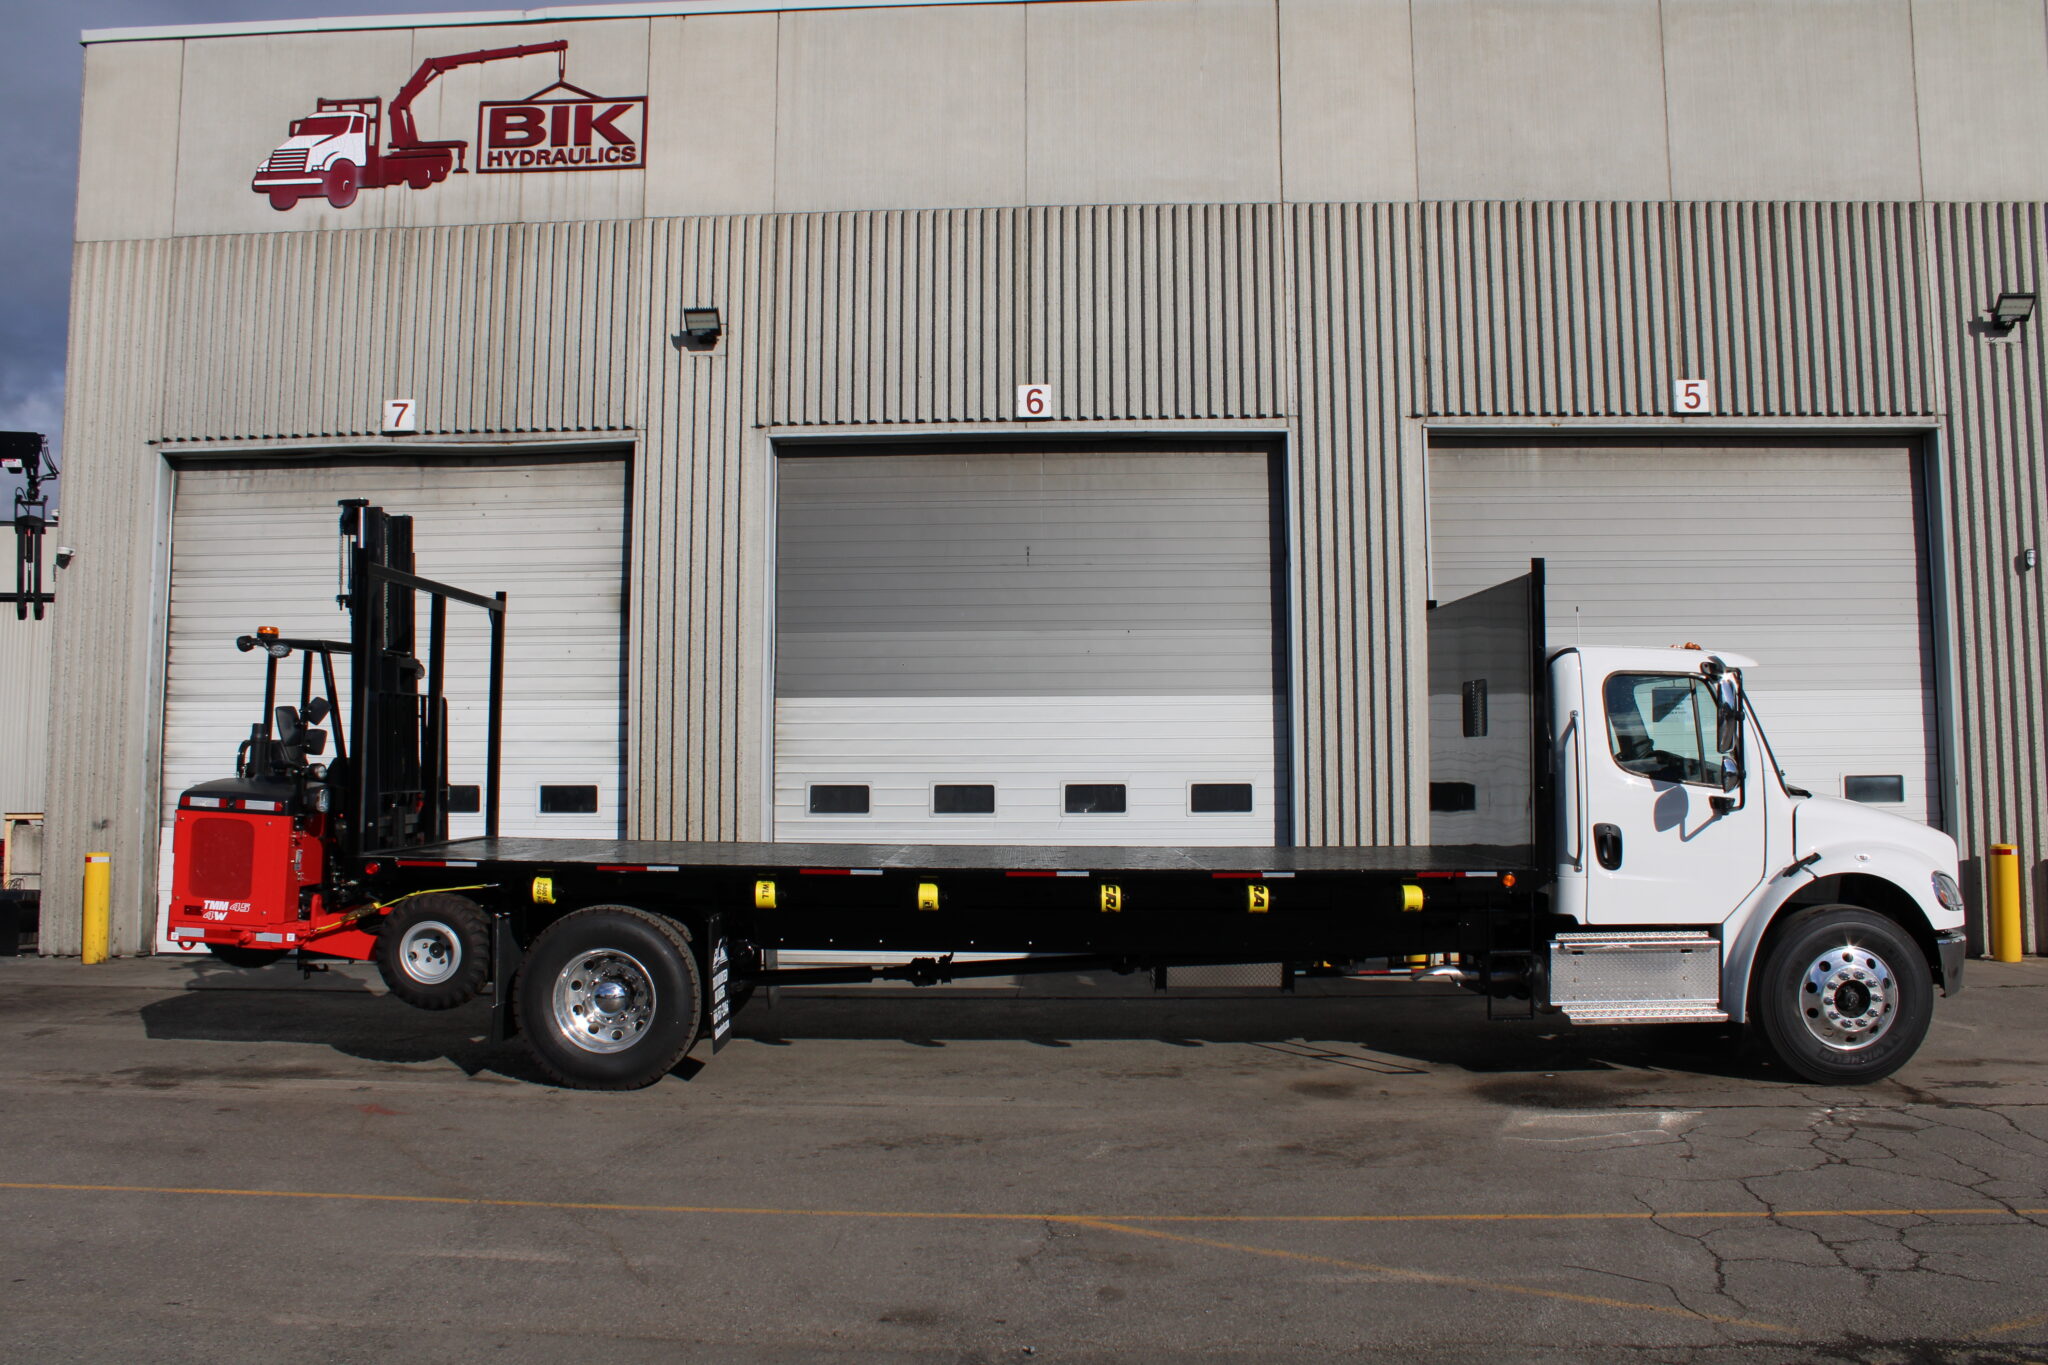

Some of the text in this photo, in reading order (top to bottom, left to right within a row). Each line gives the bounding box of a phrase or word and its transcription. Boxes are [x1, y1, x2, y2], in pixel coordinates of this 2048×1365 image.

[488, 103, 636, 149] BIK
[487, 145, 637, 167] HYDRAULICS
[1026, 388, 1043, 415] 6
[1684, 383, 1701, 409] 5
[392, 403, 409, 427] 7
[202, 910, 228, 920] 4W
[203, 900, 251, 912] TMM 45
[1819, 1046, 1885, 1064] MICHELIN
